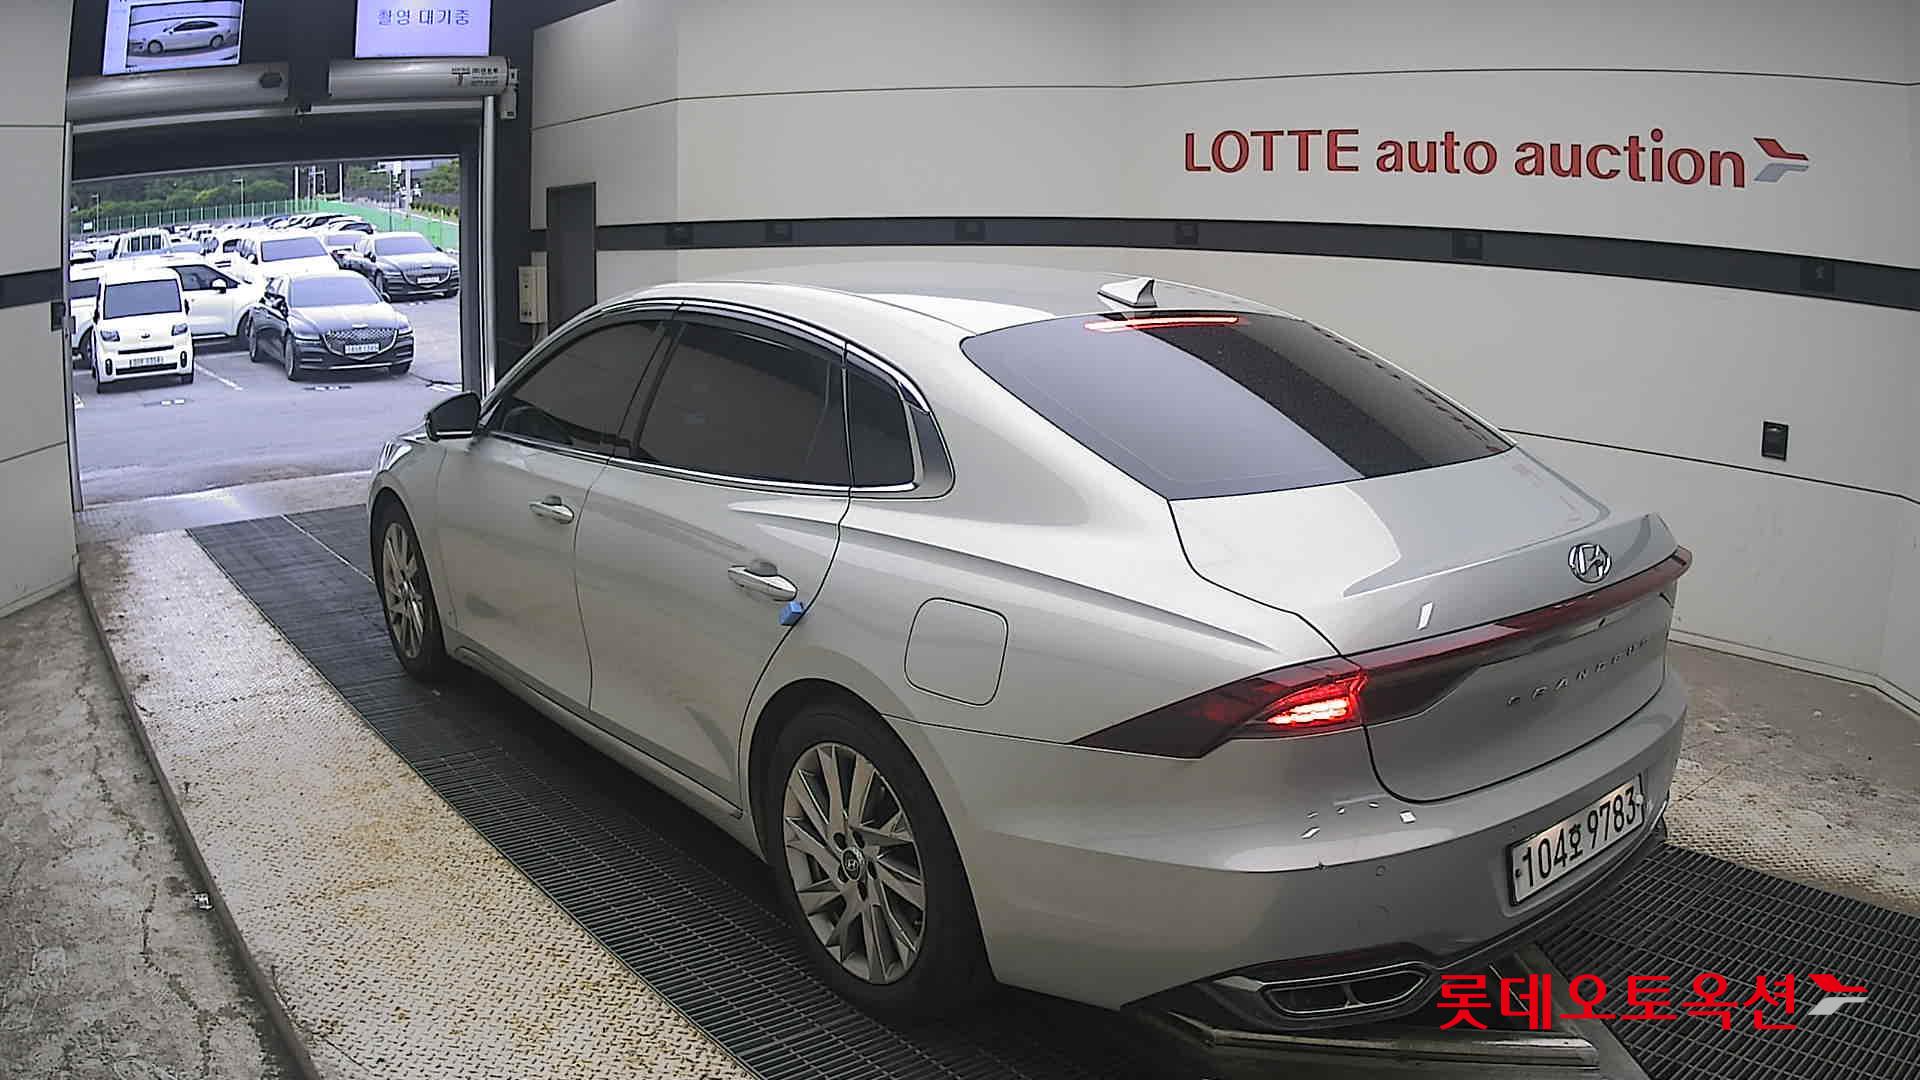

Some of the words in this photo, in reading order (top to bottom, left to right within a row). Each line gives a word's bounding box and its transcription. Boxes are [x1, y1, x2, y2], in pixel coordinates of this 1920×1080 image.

[418, 8, 471, 26] 대기중
[1185, 129, 1359, 173] LOTTE
[1376, 130, 1498, 176] auto
[1514, 128, 1746, 189] auction
[1522, 823, 1584, 888] 104호
[1586, 785, 1637, 850] 9783
